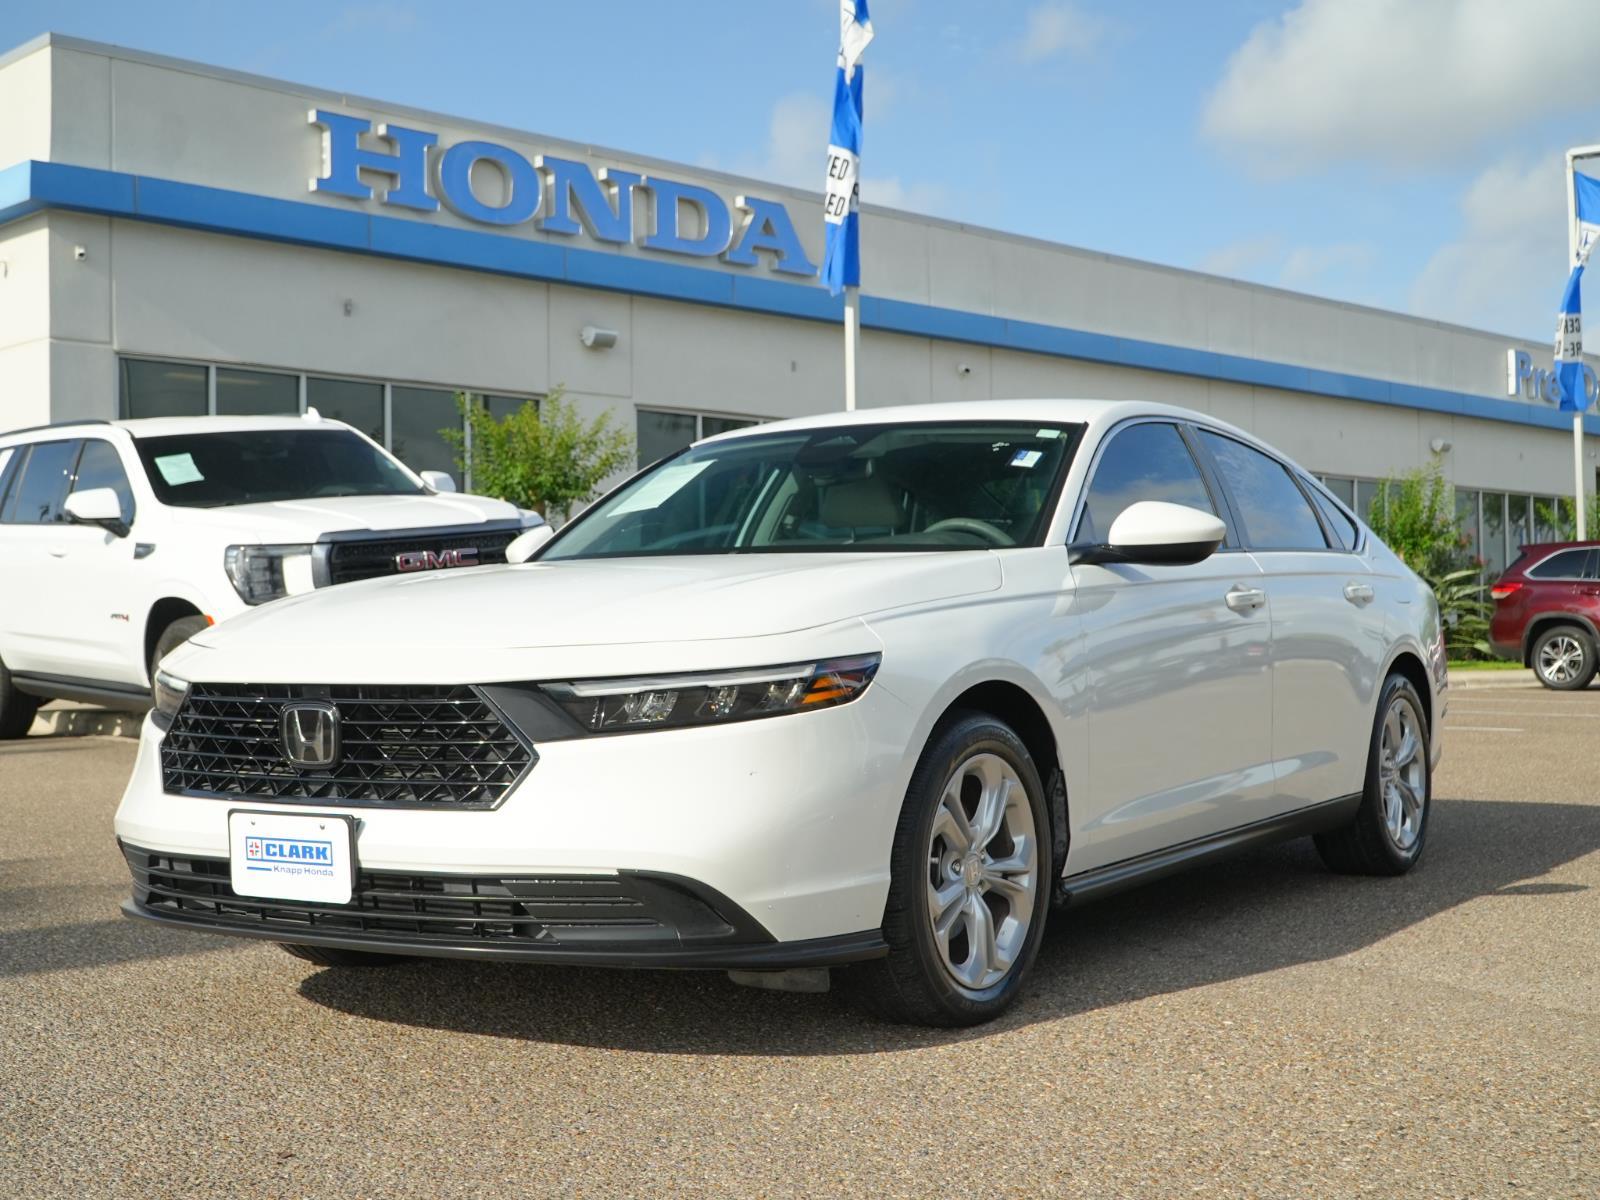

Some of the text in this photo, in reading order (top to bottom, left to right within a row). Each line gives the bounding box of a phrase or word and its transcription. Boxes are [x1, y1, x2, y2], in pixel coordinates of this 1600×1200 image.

[307, 109, 818, 277] HONDA
[825, 192, 846, 216] ED
[396, 547, 479, 571] GMC
[265, 843, 329, 860] CLARK
[273, 865, 334, 877] Knapp Honda
